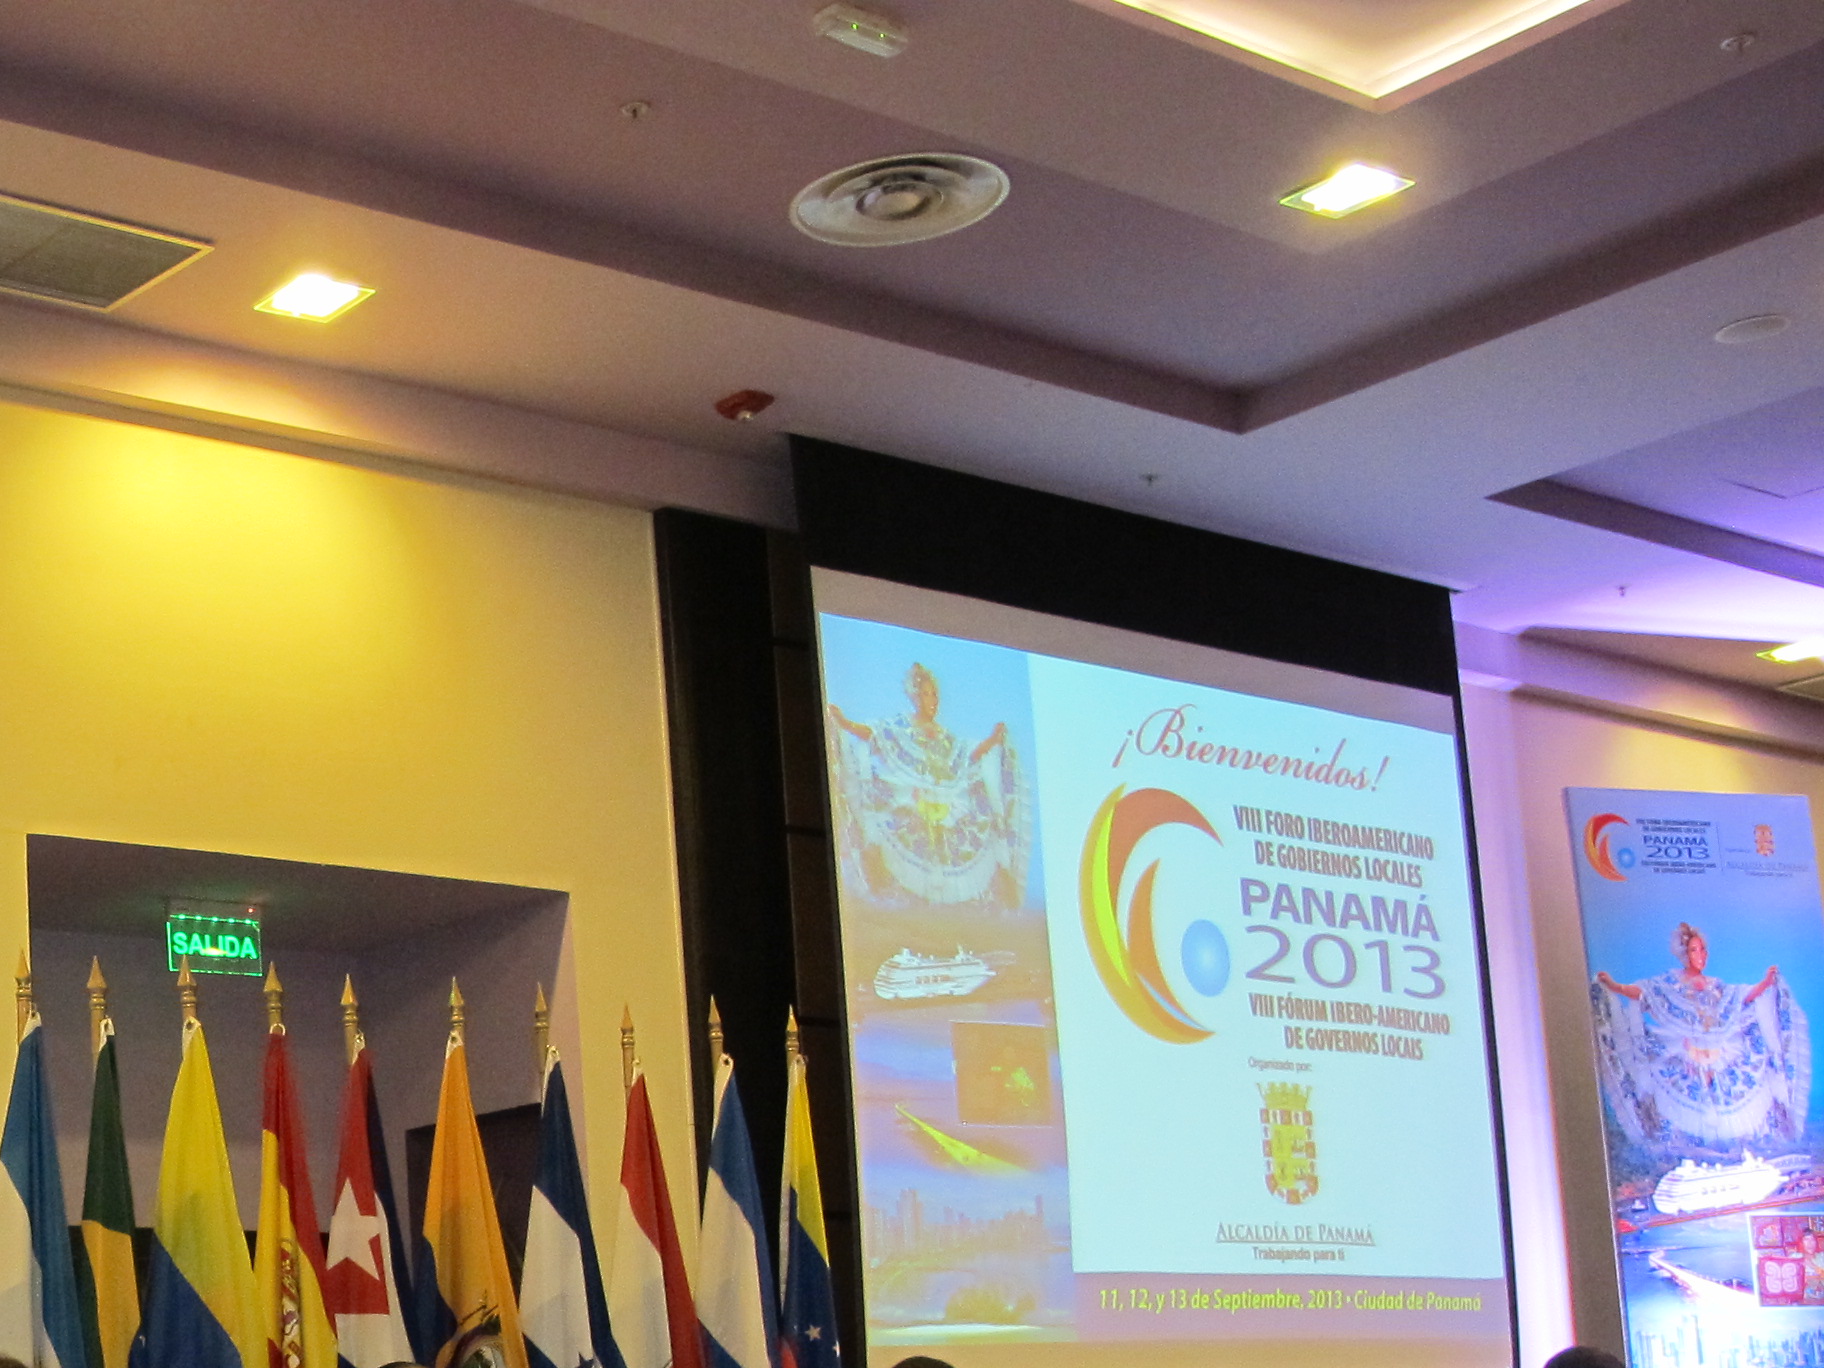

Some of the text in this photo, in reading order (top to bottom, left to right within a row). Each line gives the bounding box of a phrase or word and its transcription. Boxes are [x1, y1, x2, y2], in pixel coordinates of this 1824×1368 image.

[1112, 703, 1390, 792] ¡Bienvenidos!
[1233, 804, 1435, 861] VIII FORO IBEROAMERICANO
[1647, 846, 1710, 859] 2013
[1254, 839, 1423, 888] DE GOBIERNOS LOCALES
[1240, 877, 1440, 942] PANAMÁ
[172, 931, 259, 960] SALIDA
[1245, 925, 1447, 1000] 2013
[1249, 992, 1451, 1035] VIII FÓRUM IBERO-AMERICANO
[1284, 1026, 1424, 1061] DE GOVERNOS LOCAIS
[1100, 1288, 1124, 1312] 11,
[1129, 1288, 1152, 1311] 12,
[1155, 1292, 1166, 1315] y
[1169, 1289, 1188, 1309] 13
[1191, 1288, 1210, 1309] de
[1307, 1289, 1344, 1309] 2013
[1354, 1290, 1404, 1310] Ciudad
[1406, 1290, 1424, 1310] de
[1426, 1291, 1482, 1311] Panamá
